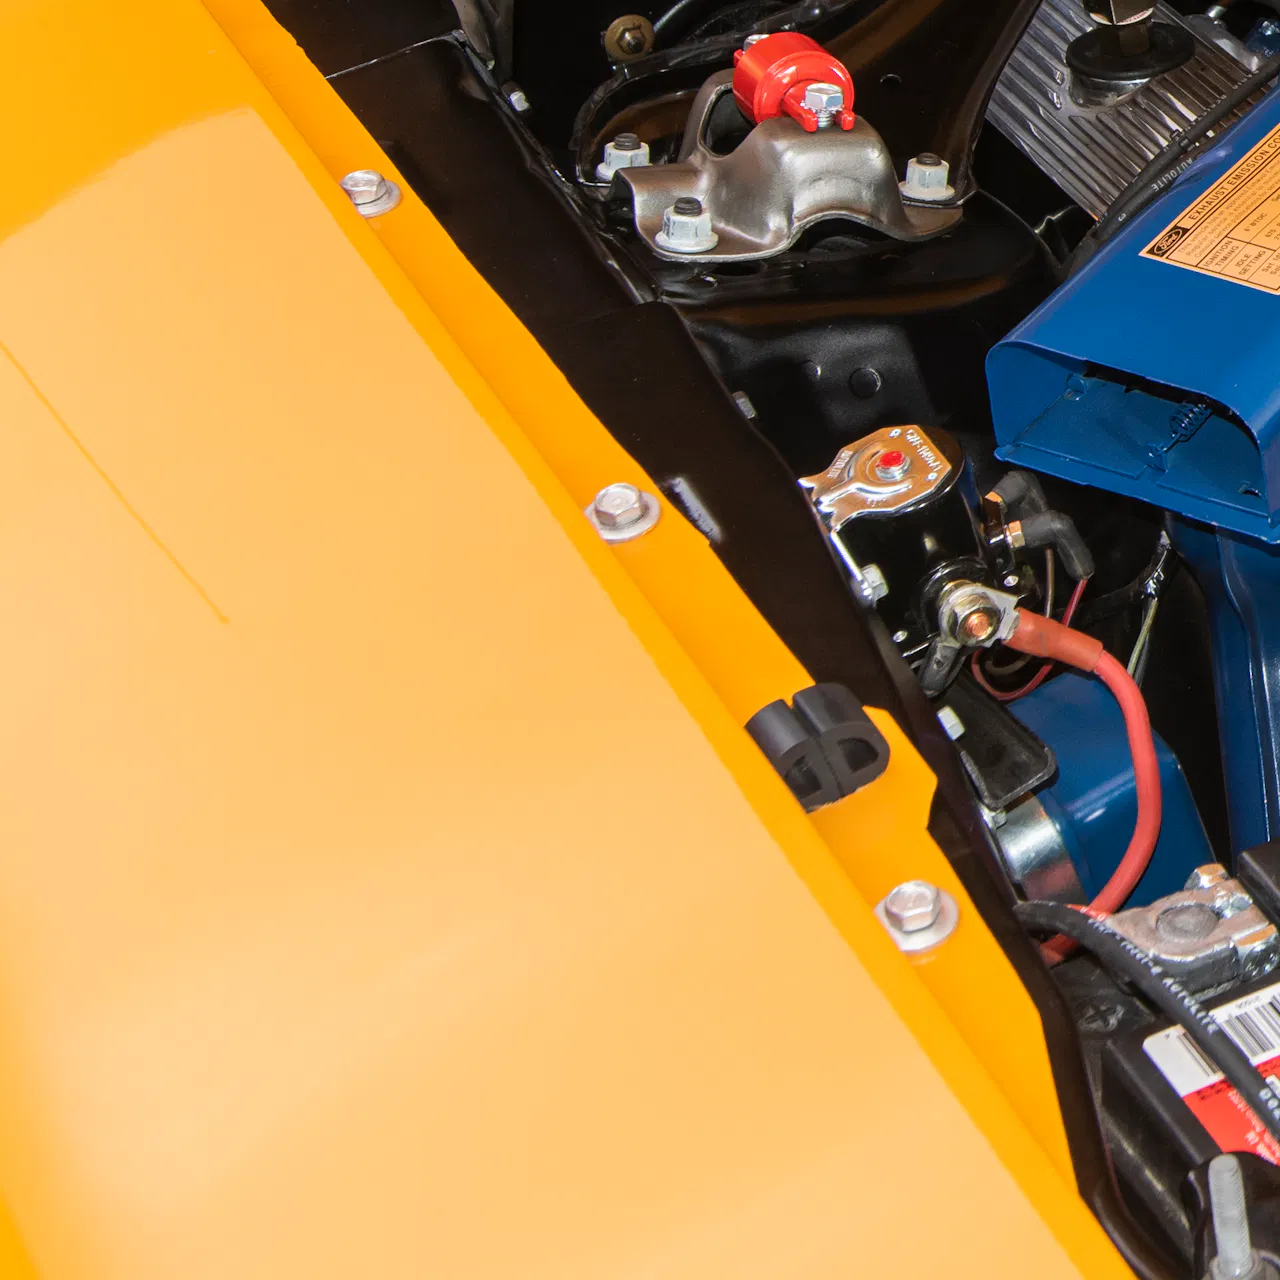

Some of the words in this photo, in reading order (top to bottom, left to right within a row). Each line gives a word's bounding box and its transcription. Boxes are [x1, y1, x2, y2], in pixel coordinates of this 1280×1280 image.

[1151, 157, 1194, 192] AUTOLITE
[1186, 185, 1230, 220] EXHAUST
[1225, 149, 1270, 185] EMISSION
[1201, 240, 1234, 266] IGNITION
[1214, 245, 1240, 266] TIMING
[1233, 253, 1252, 267] IDLE
[1237, 250, 1268, 275] SETTING
